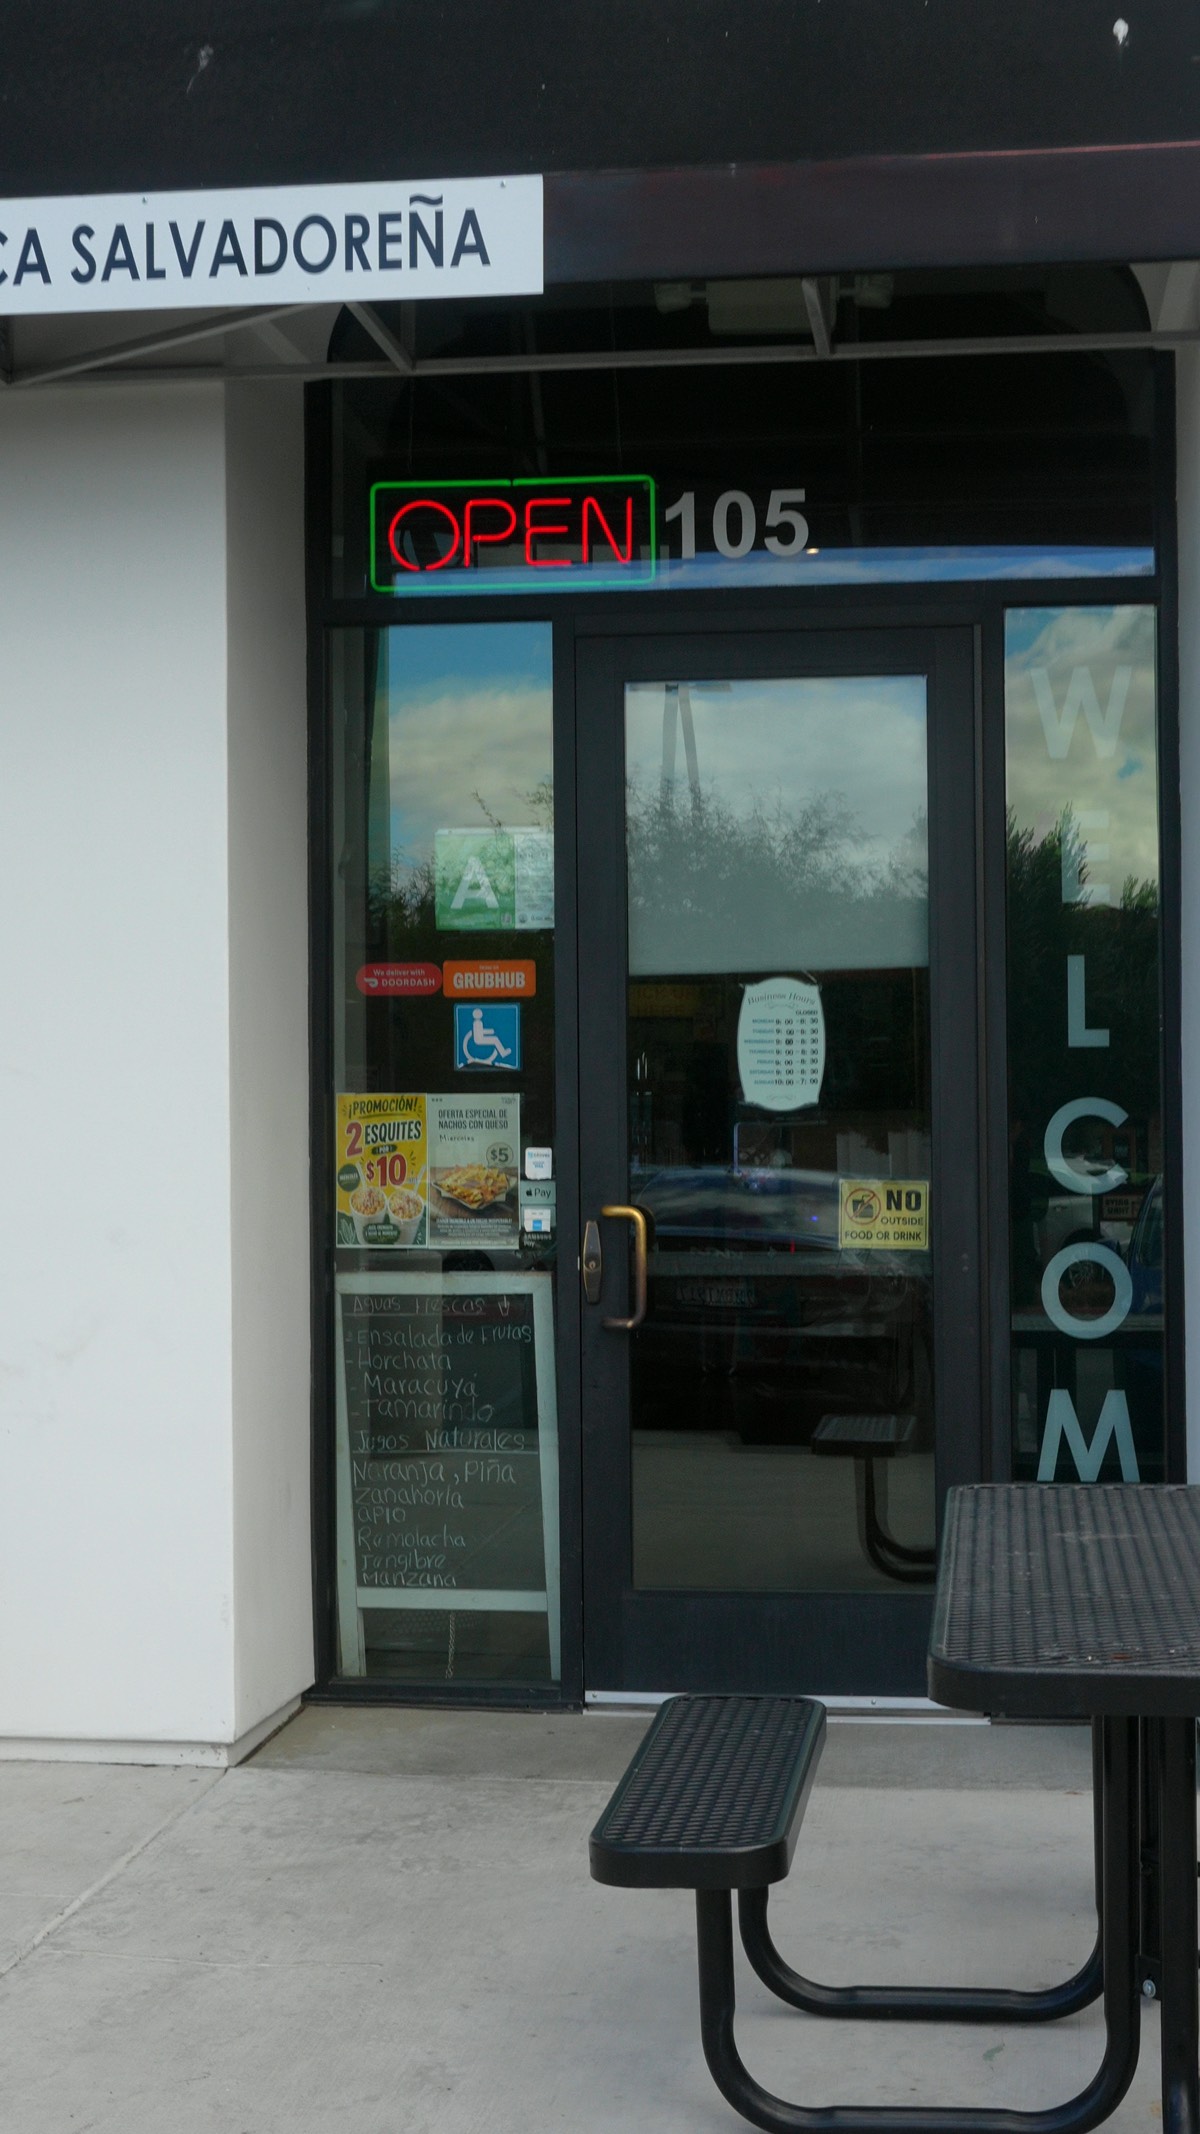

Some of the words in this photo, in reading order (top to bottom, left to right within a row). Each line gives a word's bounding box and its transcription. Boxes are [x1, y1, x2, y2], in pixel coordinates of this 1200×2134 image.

[0, 227, 52, 286] A
[70, 193, 491, 285] SALVADOREÑA
[389, 495, 633, 571] OPEN
[665, 487, 809, 560] 105
[450, 855, 500, 909] A
[382, 978, 436, 987] DOORDASH
[386, 968, 409, 976] deliver
[453, 972, 526, 989] GRUBHUB
[748, 992, 786, 1006] Business
[788, 992, 816, 1006] Hours
[1030, 665, 1140, 1483] WELCOM
[348, 1096, 418, 1120] ¡PROMOCIÓN!
[438, 1109, 464, 1119] OFERTA
[466, 1109, 496, 1118] ESPECIAL
[499, 1109, 507, 1118] DE
[438, 1120, 466, 1129] NACHOS
[468, 1120, 484, 1129] CON
[485, 1120, 508, 1129] QUESO
[346, 1122, 362, 1157] 2
[364, 1120, 422, 1145] ESQUITES
[490, 1148, 508, 1162] $5
[366, 1153, 407, 1187] $10
[534, 1188, 551, 1198] Pay
[886, 1189, 922, 1212] NO
[880, 1216, 924, 1226] OUTSIDE
[844, 1230, 873, 1240] FOOD
[876, 1231, 890, 1240] OR
[893, 1231, 922, 1240] DRINK
[353, 1296, 401, 1314] Aguas
[357, 1324, 452, 1348] Ensalada
[456, 1323, 473, 1344] de
[481, 1324, 532, 1344] Frutas
[358, 1346, 452, 1370] Horchata
[361, 1397, 494, 1422] Tamarindo
[354, 1430, 410, 1452] Jugos
[426, 1426, 524, 1452] Naturales
